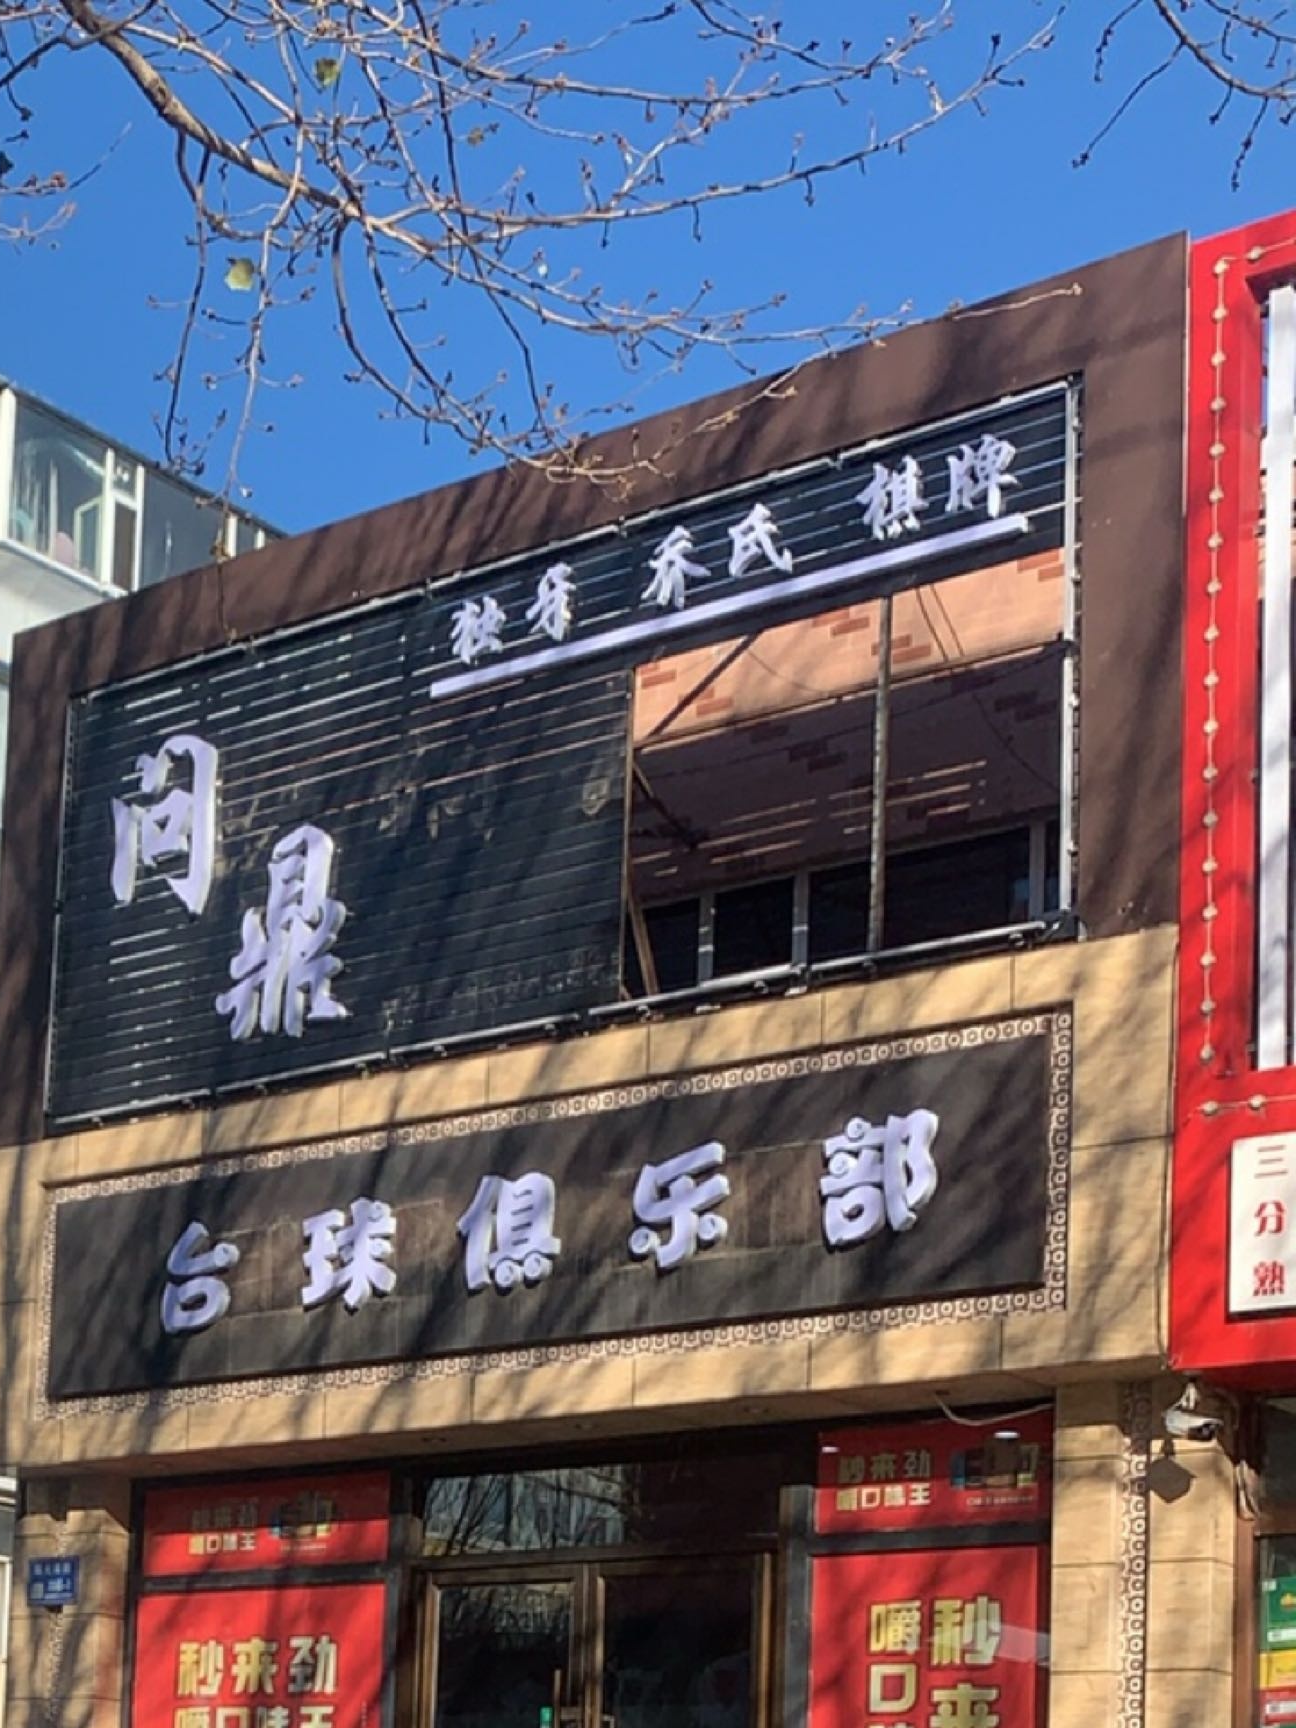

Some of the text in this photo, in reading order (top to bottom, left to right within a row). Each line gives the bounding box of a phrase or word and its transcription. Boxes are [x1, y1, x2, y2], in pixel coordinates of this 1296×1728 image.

[642, 503, 793, 609] 乔氏
[858, 433, 1022, 539] 棋牌
[113, 734, 351, 1042] 问鼎
[160, 1108, 941, 1335] 台球俱乐部
[1253, 1145, 1288, 1296] 三分熟
[177, 1635, 337, 1697] 秒来劲
